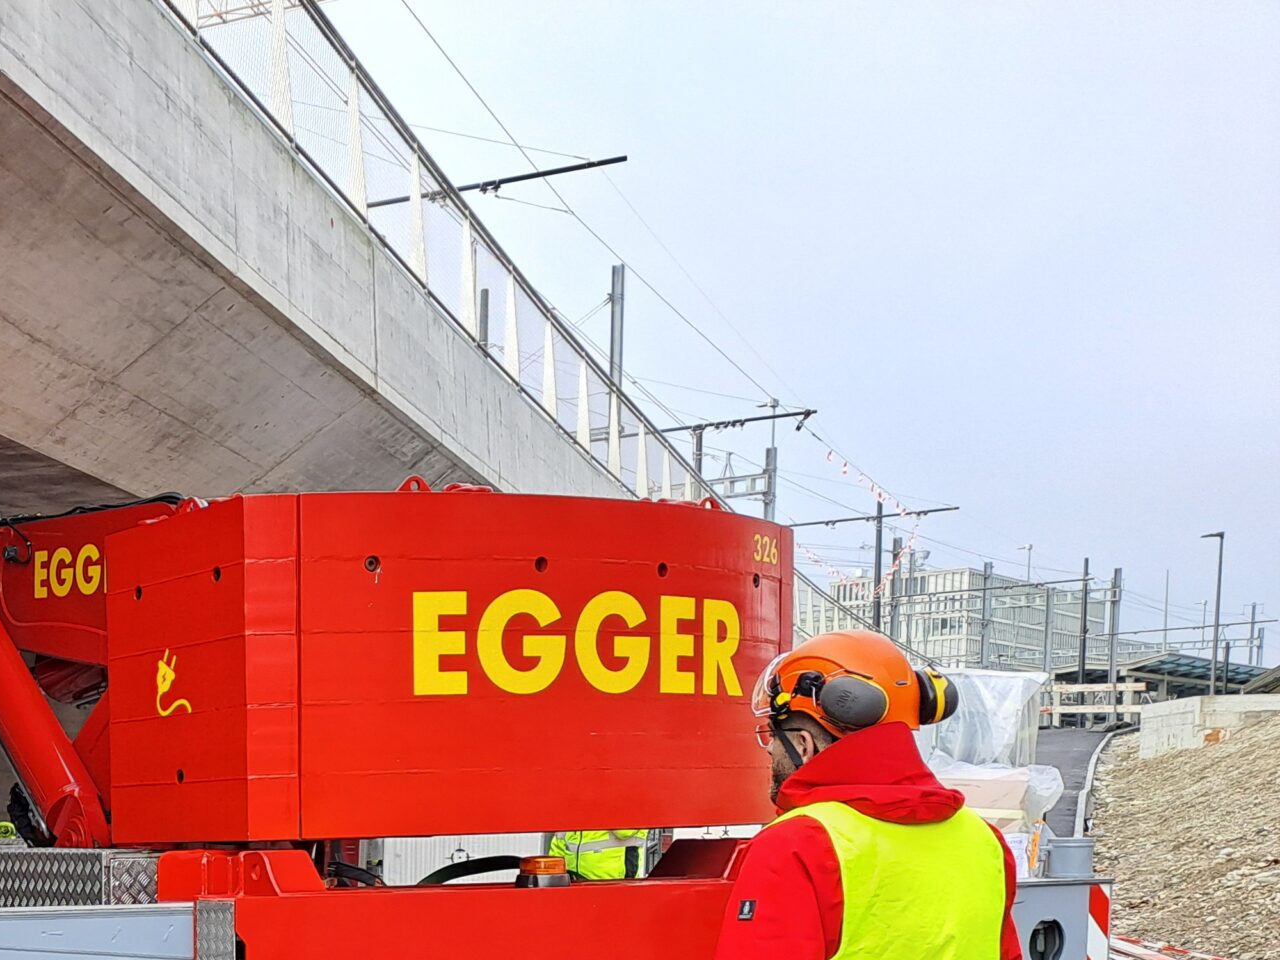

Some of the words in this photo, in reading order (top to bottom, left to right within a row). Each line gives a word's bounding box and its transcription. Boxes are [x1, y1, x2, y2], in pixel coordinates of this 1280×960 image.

[34, 543, 107, 599] EGG
[753, 533, 778, 565] 326
[412, 588, 743, 696] EGGER
